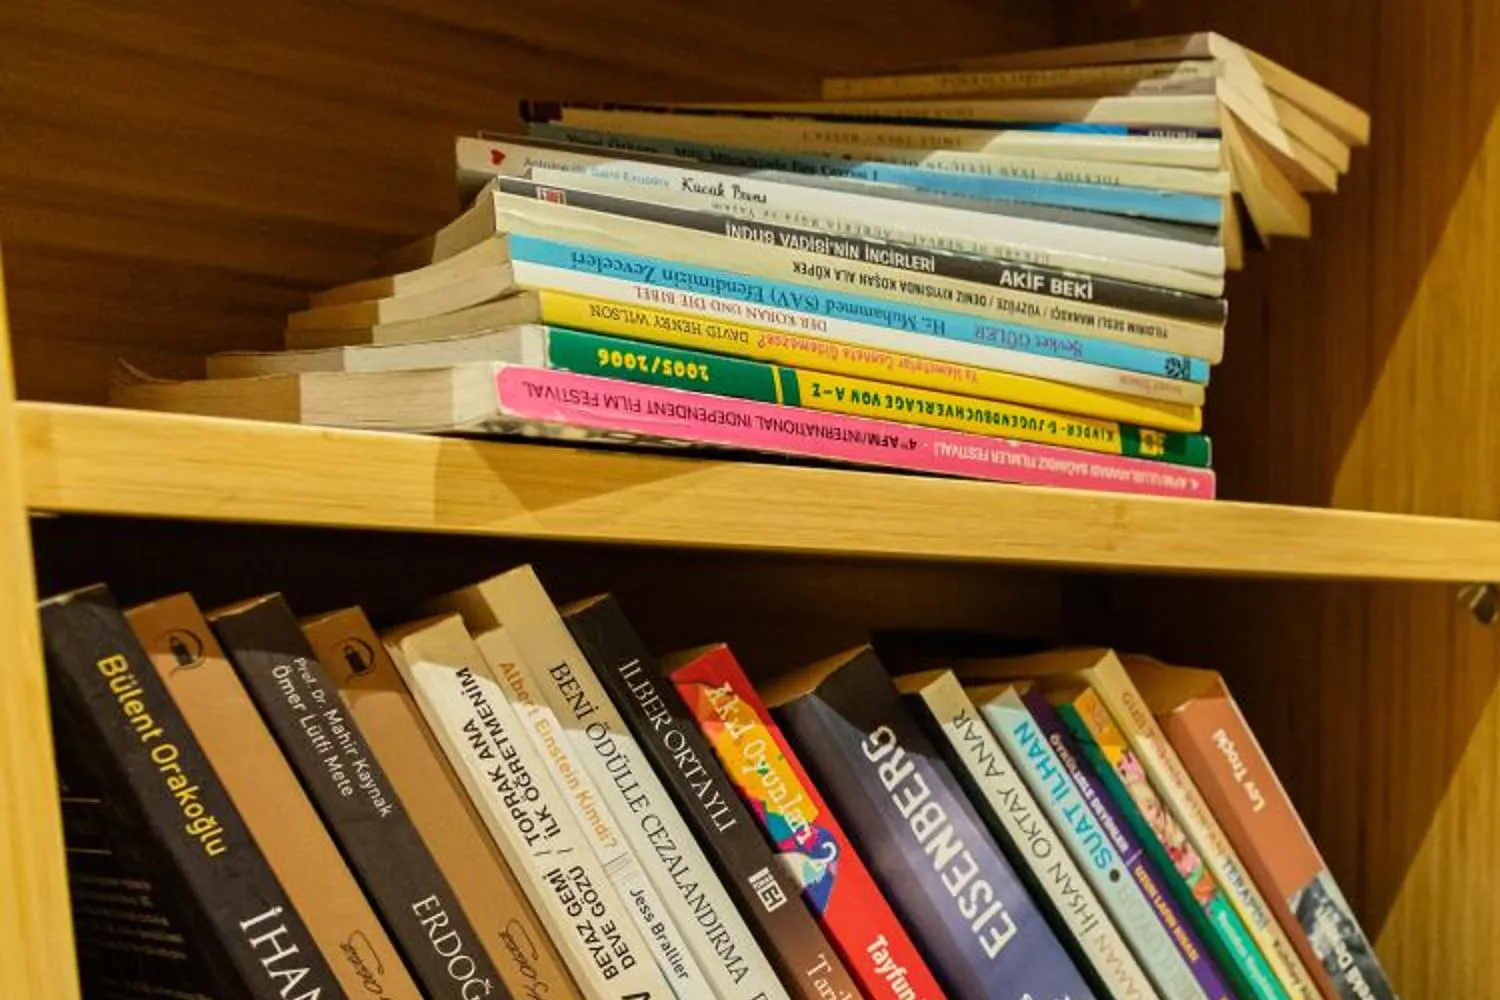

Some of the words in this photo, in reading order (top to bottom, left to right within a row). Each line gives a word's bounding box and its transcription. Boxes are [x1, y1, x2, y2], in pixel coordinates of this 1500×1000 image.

[725, 222, 776, 246] İNDUS
[864, 243, 936, 273] İNCİRLERİ
[571, 250, 656, 284] Zevceleri
[793, 260, 832, 281] KÖPEK
[835, 269, 855, 284] ALA
[858, 274, 898, 292] KOŞAN
[1000, 267, 1045, 292] AKİF
[1051, 277, 1094, 300] BEKİ
[634, 285, 676, 304] BIBEL
[661, 269, 766, 304] Efendimizin
[678, 294, 707, 309] DIE
[769, 286, 820, 312] (SAV)
[900, 280, 954, 301] KIYISINDA
[955, 288, 988, 307] DENİZ
[590, 306, 650, 327] WILSON
[711, 300, 743, 316] UND
[748, 306, 798, 328] KORAN
[824, 300, 918, 333] Muhammed
[996, 297, 1041, 318] YÜZYÜZE
[1097, 316, 1125, 332] SESLİ
[654, 315, 703, 338] HENRY
[706, 326, 751, 344] DAVID
[800, 318, 829, 333] DER
[974, 322, 1032, 348] GÜLER
[1126, 322, 1169, 339] YILDIRIM
[597, 347, 710, 382] 2005/2006
[522, 380, 602, 407] FESTIVAL
[603, 394, 641, 413] FILM
[850, 386, 882, 407] VON
[642, 403, 751, 427] INDEPENDENT
[885, 393, 1045, 431] JUGENDBUCHVERLAGE
[271, 663, 308, 713] Ömer
[323, 755, 354, 798] Mete
[456, 666, 540, 803] ÖĞRETMENİM
[463, 718, 494, 761] ANA
[949, 711, 1006, 780] ANAR
[96, 653, 165, 745] Bülent
[149, 742, 228, 858] Orakoğlu
[322, 706, 360, 757] Mahir
[351, 757, 393, 818] Kaynak
[498, 660, 536, 717] Albert
[534, 720, 580, 791] Einstein
[574, 788, 619, 850] Kimdi?
[1012, 719, 1071, 802] İLHAN
[663, 728, 738, 834] ORTAYLI
[1243, 780, 1266, 814] Lev
[487, 764, 542, 848] TOPRAK
[534, 803, 562, 842] İLK
[549, 660, 600, 722] BENİ
[585, 719, 651, 814] ÖDÜLLE
[640, 811, 751, 985] CEZALANDIRMA
[995, 785, 1052, 860] OKTAY
[862, 725, 1018, 960] EISENBERG
[1063, 804, 1114, 871] SUAT
[541, 866, 583, 918] GEMİ
[567, 864, 607, 918] GÖZÜ
[1048, 861, 1099, 938] İHSAN
[575, 918, 620, 982] BEYAZ
[601, 919, 638, 971] DEVE
[629, 886, 654, 923] Jess
[651, 921, 690, 981] Brallier
